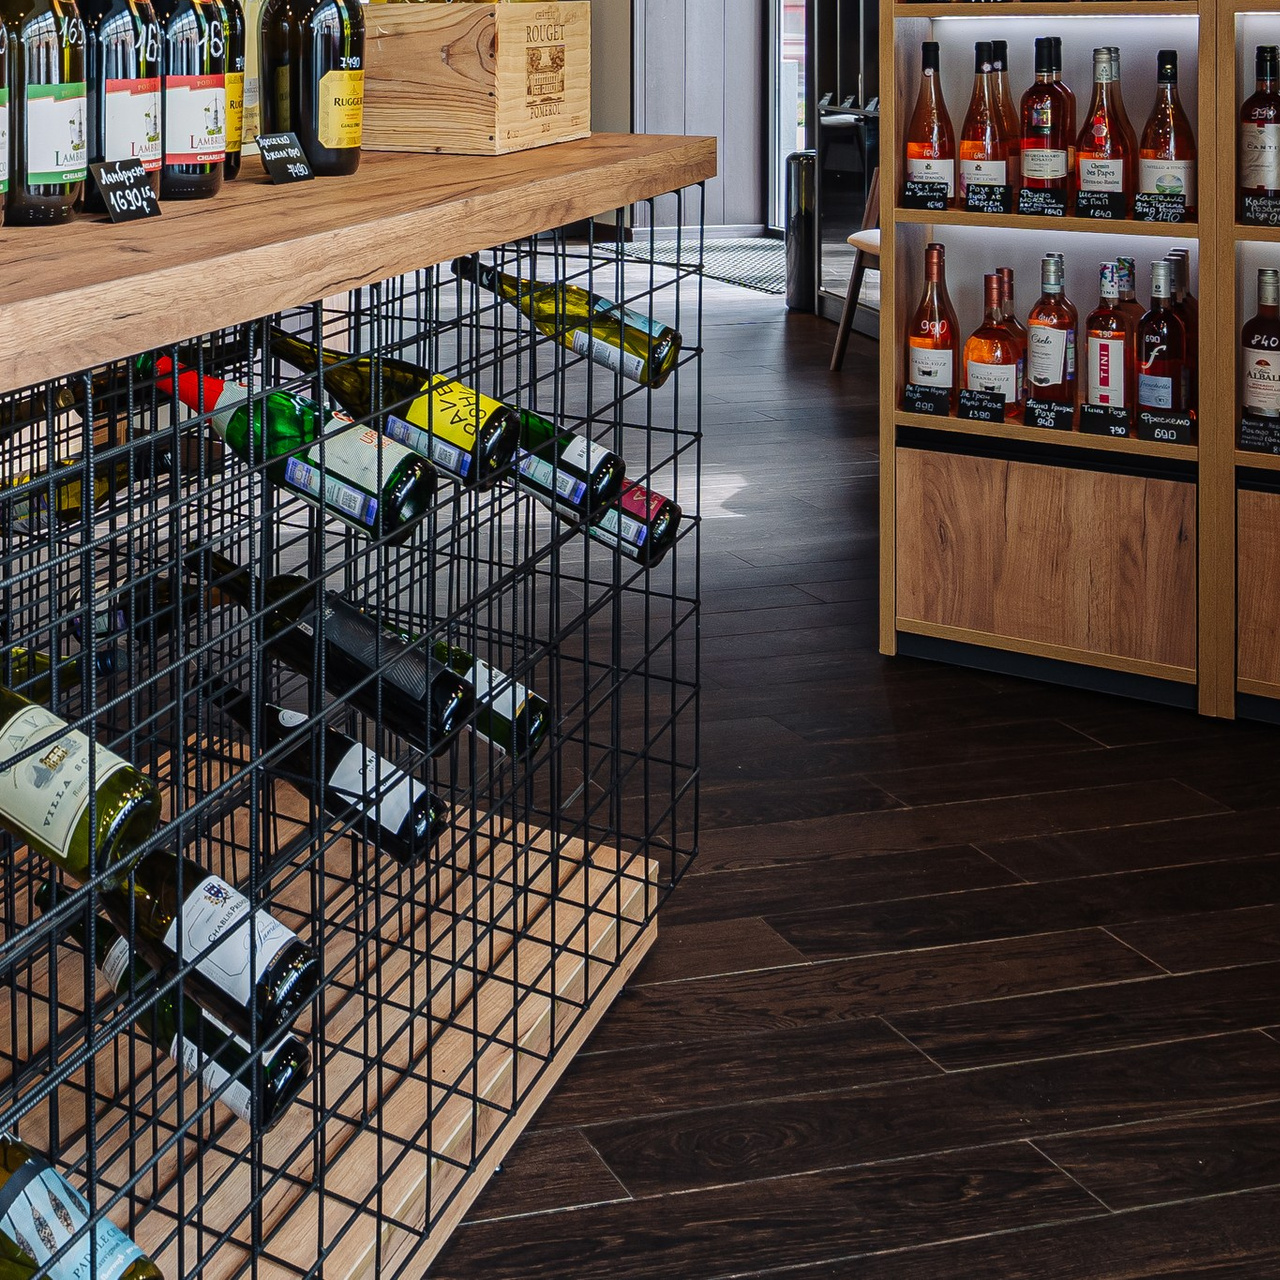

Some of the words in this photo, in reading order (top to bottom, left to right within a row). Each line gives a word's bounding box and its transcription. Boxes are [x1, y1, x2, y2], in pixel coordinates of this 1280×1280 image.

[526, 24, 565, 42] ROUGET
[340, 56, 361, 68] 7490
[529, 104, 561, 119] POMEROL
[54, 150, 86, 168] LAMBRU
[110, 190, 142, 213] 1690
[1031, 334, 1052, 344] Cielo
[1110, 427, 1125, 435] 790
[1154, 429, 1177, 440] 690
[43, 779, 73, 827] VILLA
[207, 910, 234, 943] CHABLIS
